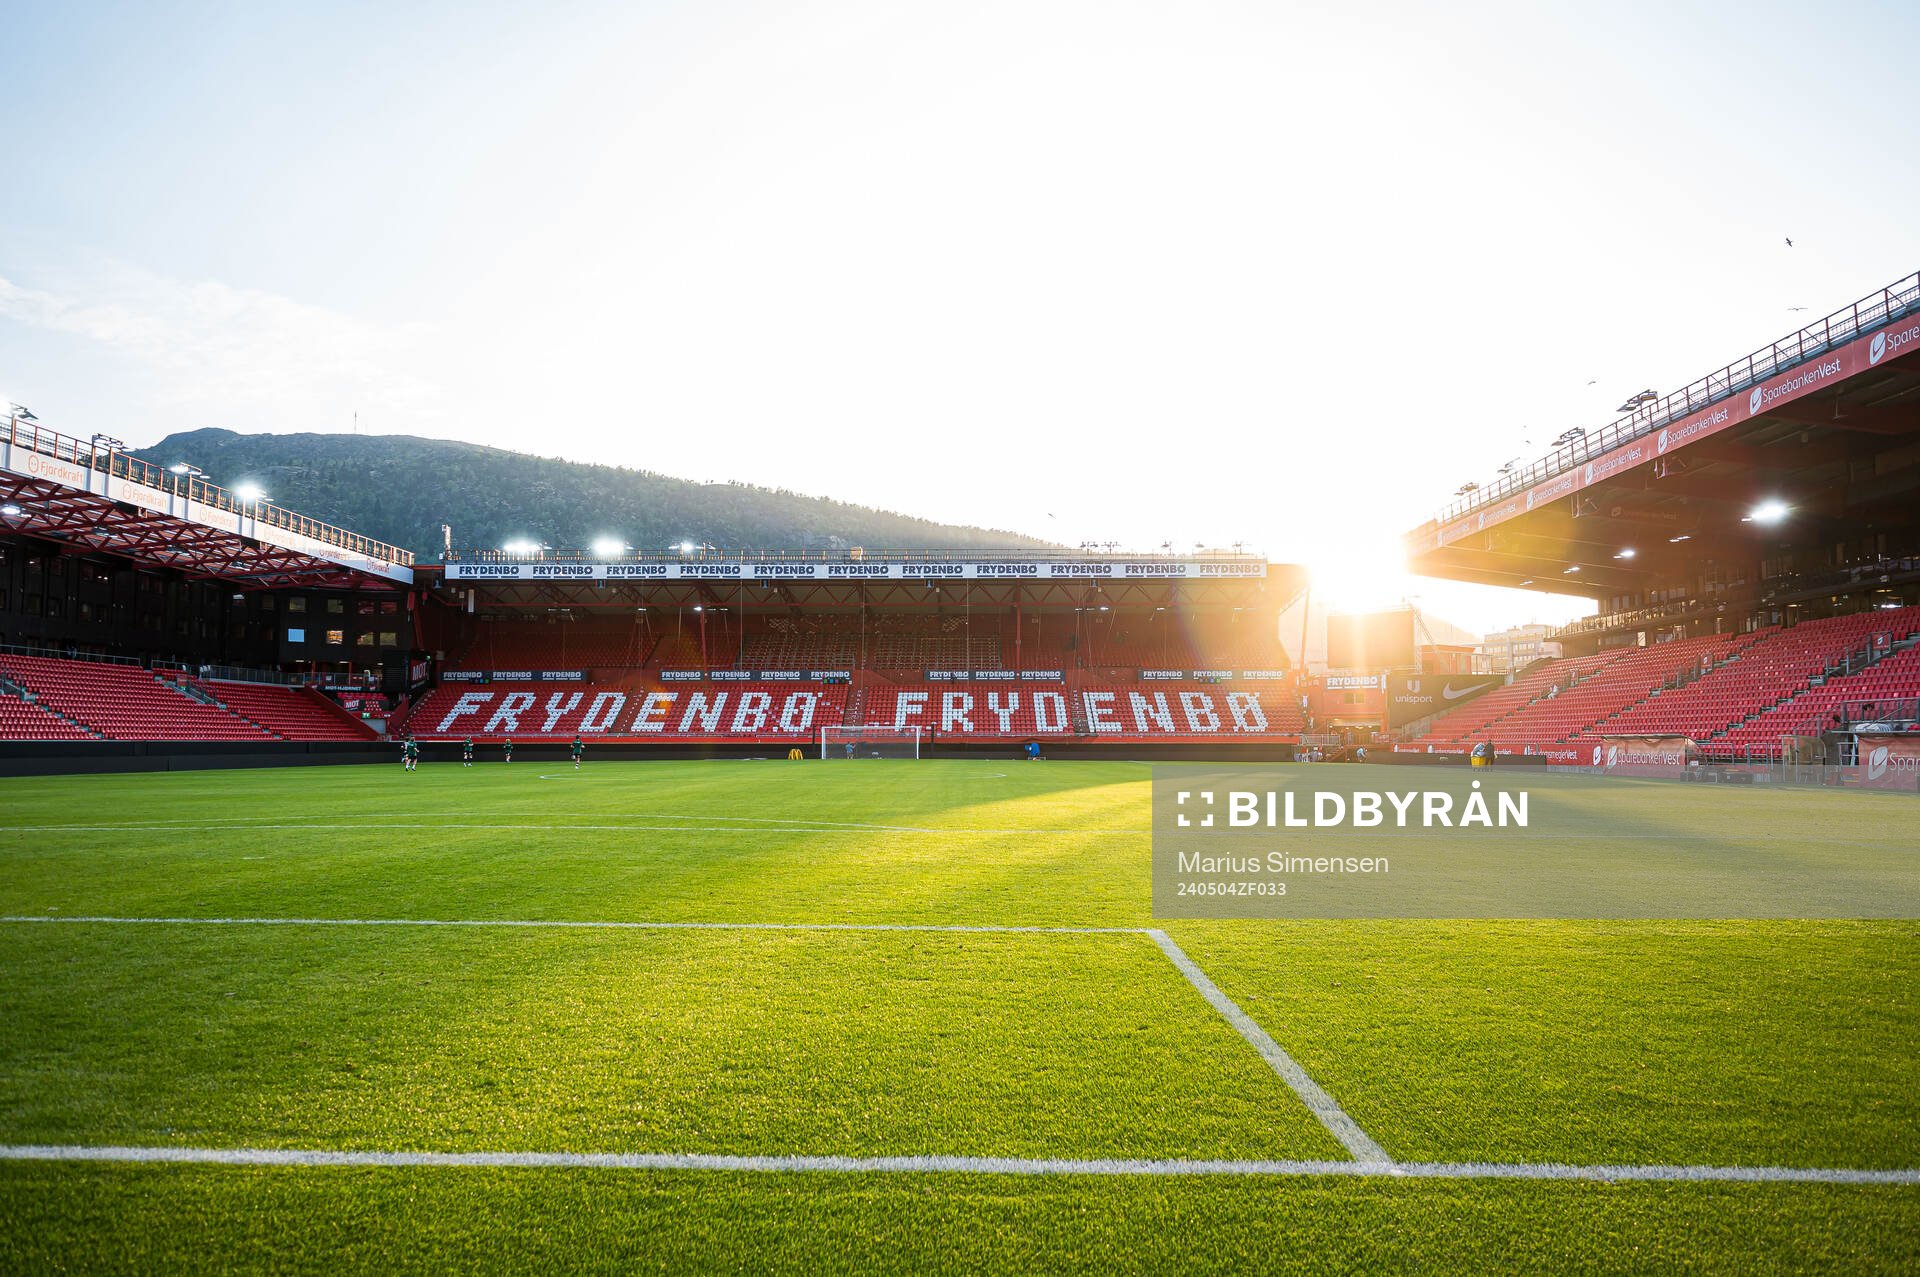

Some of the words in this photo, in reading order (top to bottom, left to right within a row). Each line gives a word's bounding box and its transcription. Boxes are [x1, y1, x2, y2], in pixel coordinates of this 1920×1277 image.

[1762, 358, 1841, 404] SparebankenVest
[1667, 409, 1729, 445] SparebankenVest
[40, 461, 83, 484] Fjordkraft
[1395, 695, 1433, 705] unisport
